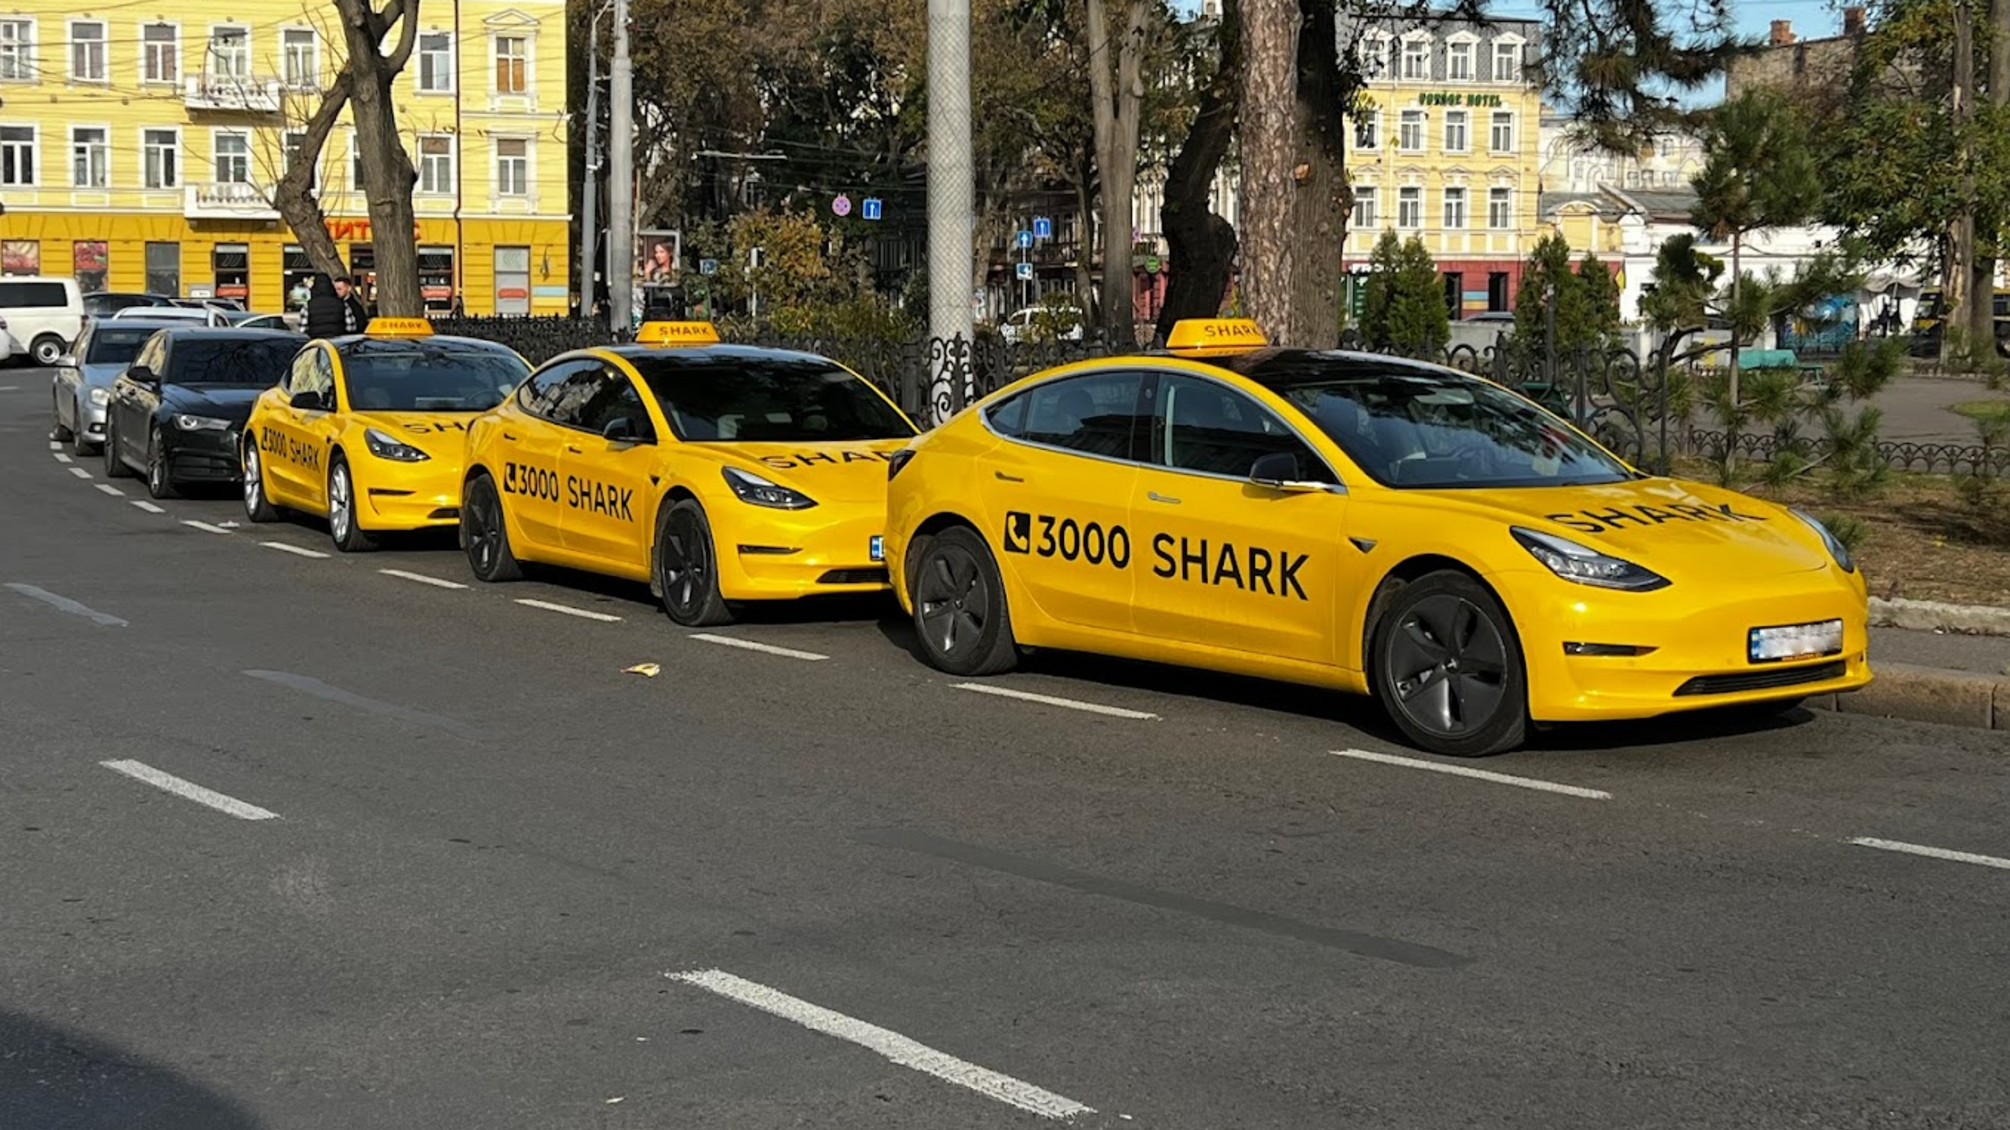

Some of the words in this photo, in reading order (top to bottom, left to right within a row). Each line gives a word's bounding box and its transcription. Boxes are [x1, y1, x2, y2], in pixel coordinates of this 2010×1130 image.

[1466, 93, 1502, 107] HOTEL
[380, 320, 422, 330] SHARK
[659, 325, 711, 336] SHARK
[1204, 324, 1262, 337] SHARK
[268, 428, 288, 459] 3000
[290, 436, 321, 474] SHARK
[759, 450, 892, 469] SHA
[518, 463, 560, 503] 3000
[567, 474, 634, 523] SHARK
[1544, 503, 1769, 533] SHARK
[1036, 514, 1131, 569] 3000
[1152, 532, 1310, 602] SHARK
